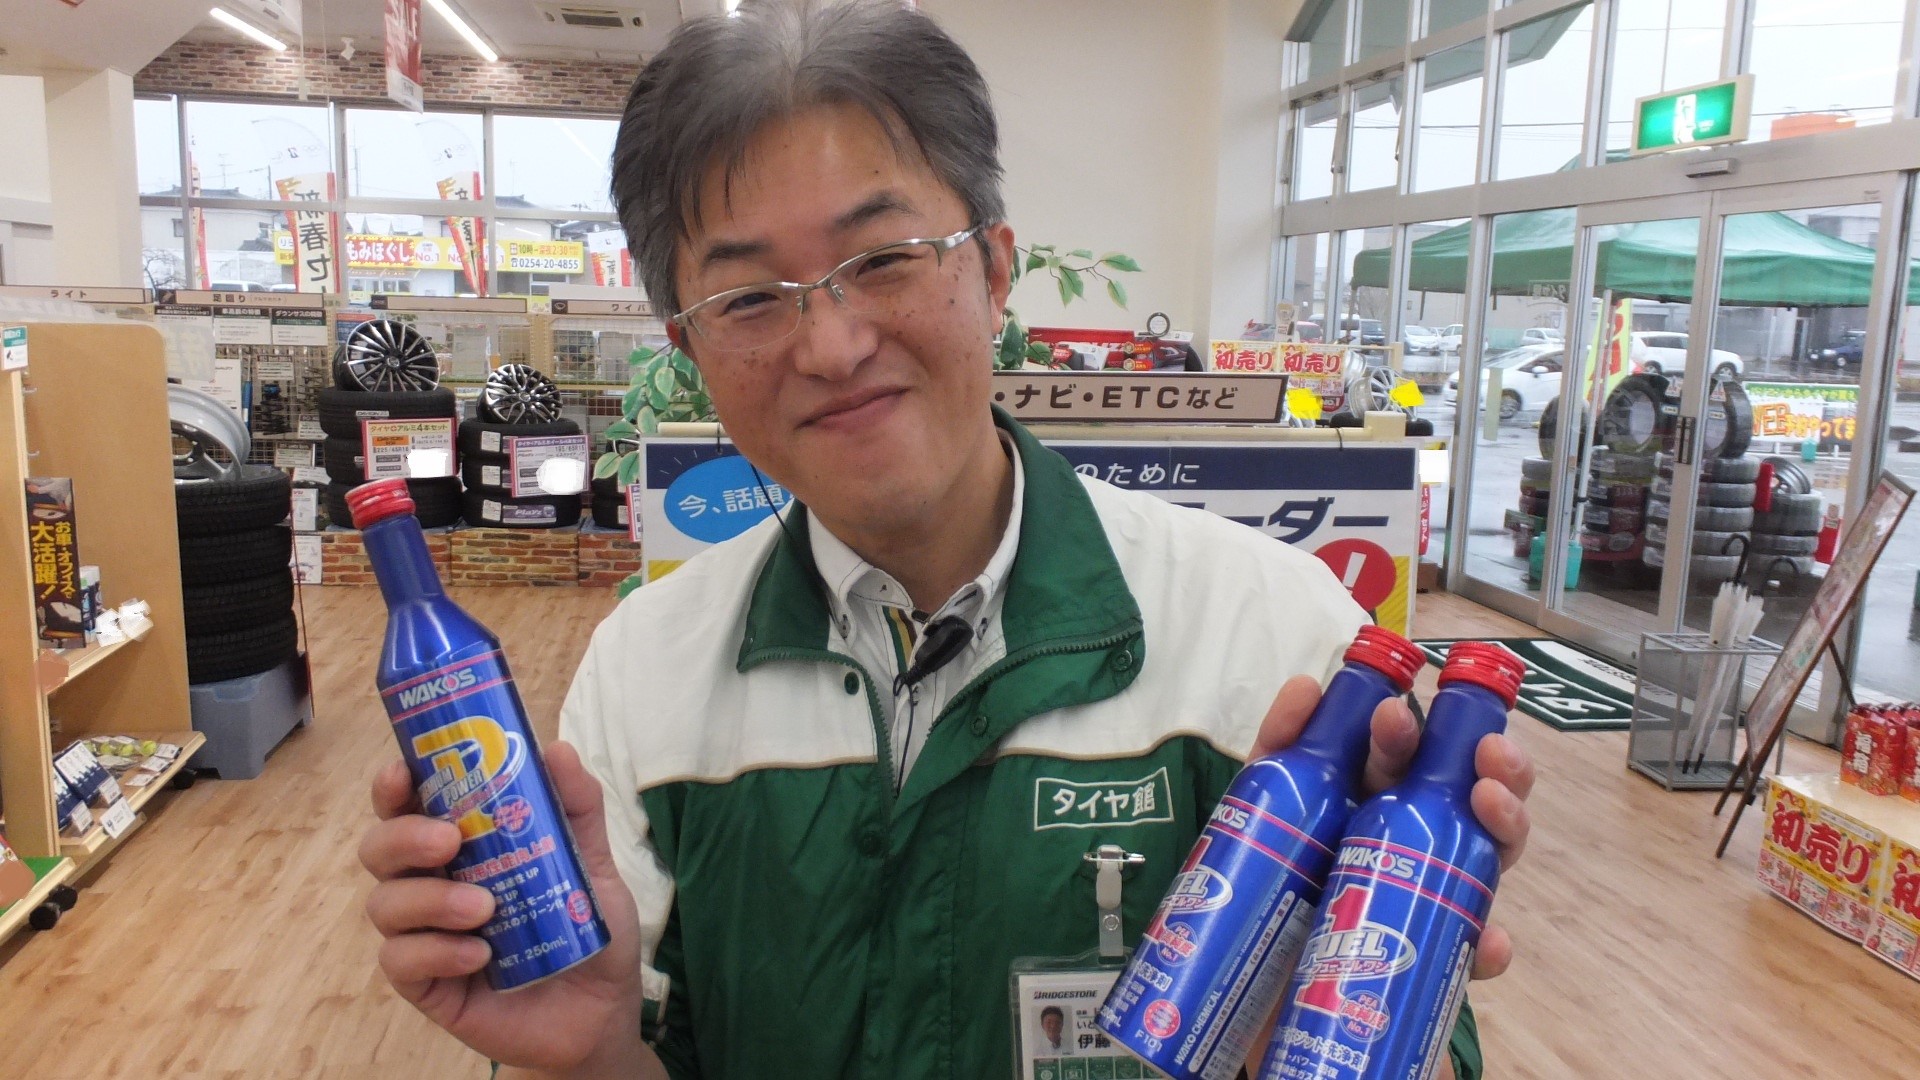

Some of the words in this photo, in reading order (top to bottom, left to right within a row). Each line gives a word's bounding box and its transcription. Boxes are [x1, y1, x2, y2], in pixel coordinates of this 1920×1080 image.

[519, 258, 579, 269] 0254-20-4855
[50, 289, 88, 299] ライト
[213, 293, 246, 303] 足回り
[1214, 349, 1274, 371] 初売り
[1283, 350, 1342, 373] 初売り
[677, 483, 794, 519] 今、話題
[55, 521, 77, 600] お車・オフィスで
[442, 768, 484, 808] POWER
[1052, 781, 1157, 820] タイヤ館
[1771, 801, 1872, 885] 初売り
[1337, 846, 1415, 880] WAKO'S
[1306, 929, 1386, 967] FUEL
[1033, 989, 1098, 1000] BRIDGESTONE
[1358, 993, 1378, 1009] PEA
[1176, 1031, 1196, 1066] WAKO
[1190, 988, 1223, 1034] CHEMICAL
[1347, 1020, 1371, 1038] No.1
[1077, 1033, 1112, 1050] 伊藤
